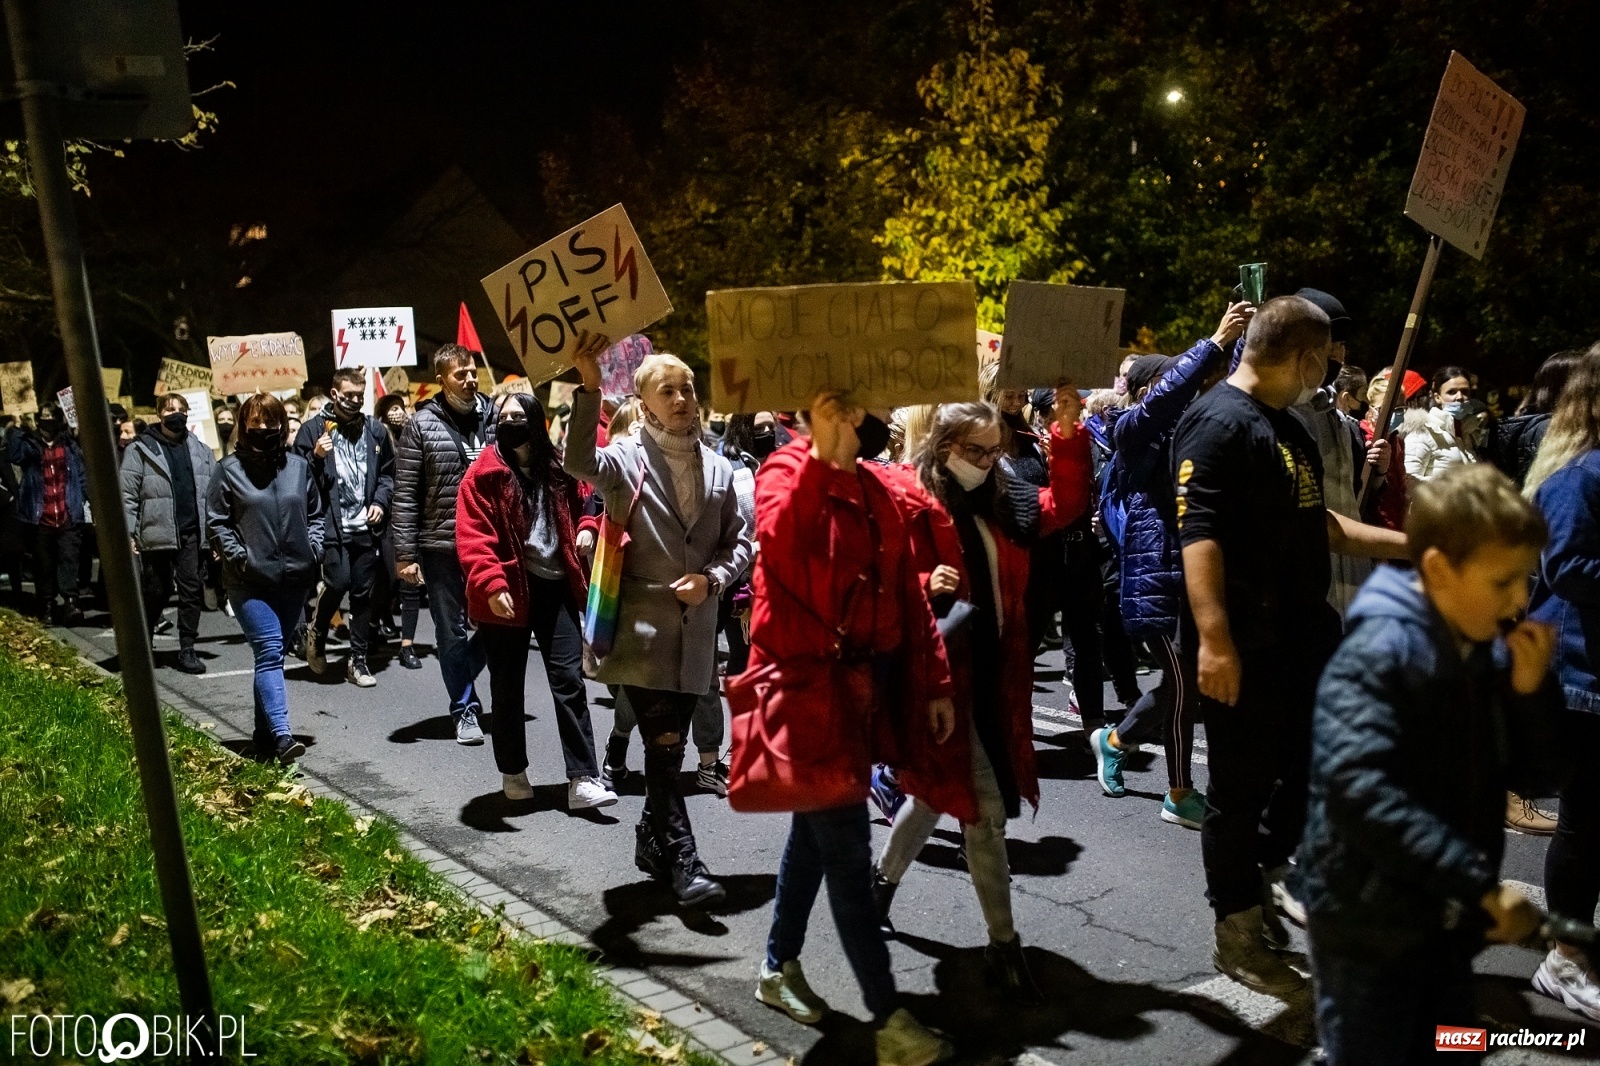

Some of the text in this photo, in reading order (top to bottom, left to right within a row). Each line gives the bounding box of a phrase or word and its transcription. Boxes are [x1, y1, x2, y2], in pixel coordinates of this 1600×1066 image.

[518, 230, 607, 304] PIS
[531, 283, 619, 354] OFF
[716, 293, 811, 345] MOJE
